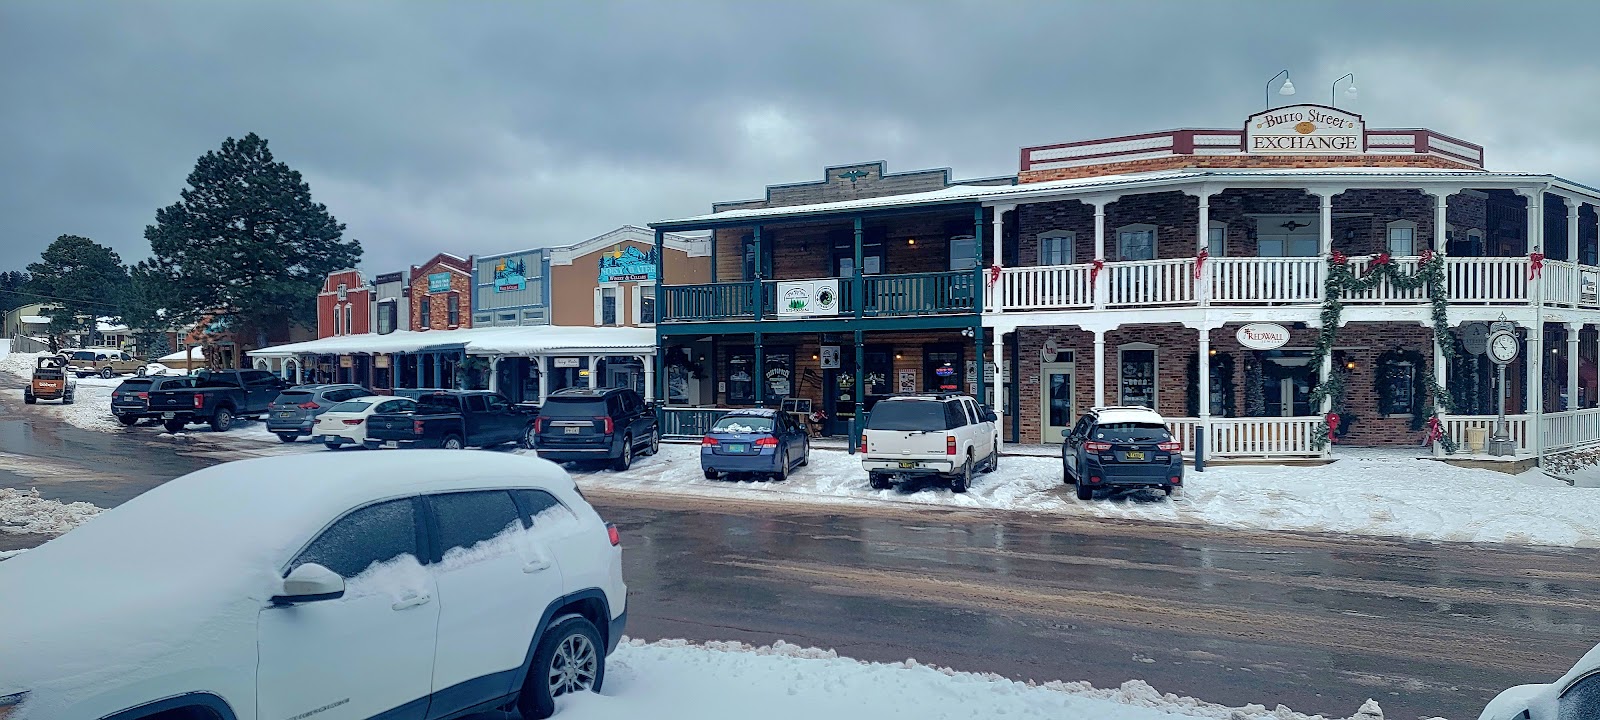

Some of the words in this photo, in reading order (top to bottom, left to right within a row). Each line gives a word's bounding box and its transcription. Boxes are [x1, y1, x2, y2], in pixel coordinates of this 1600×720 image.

[1264, 112, 1303, 128] Burro
[1308, 109, 1345, 128] Street
[1253, 137, 1357, 149] EXCHANGE
